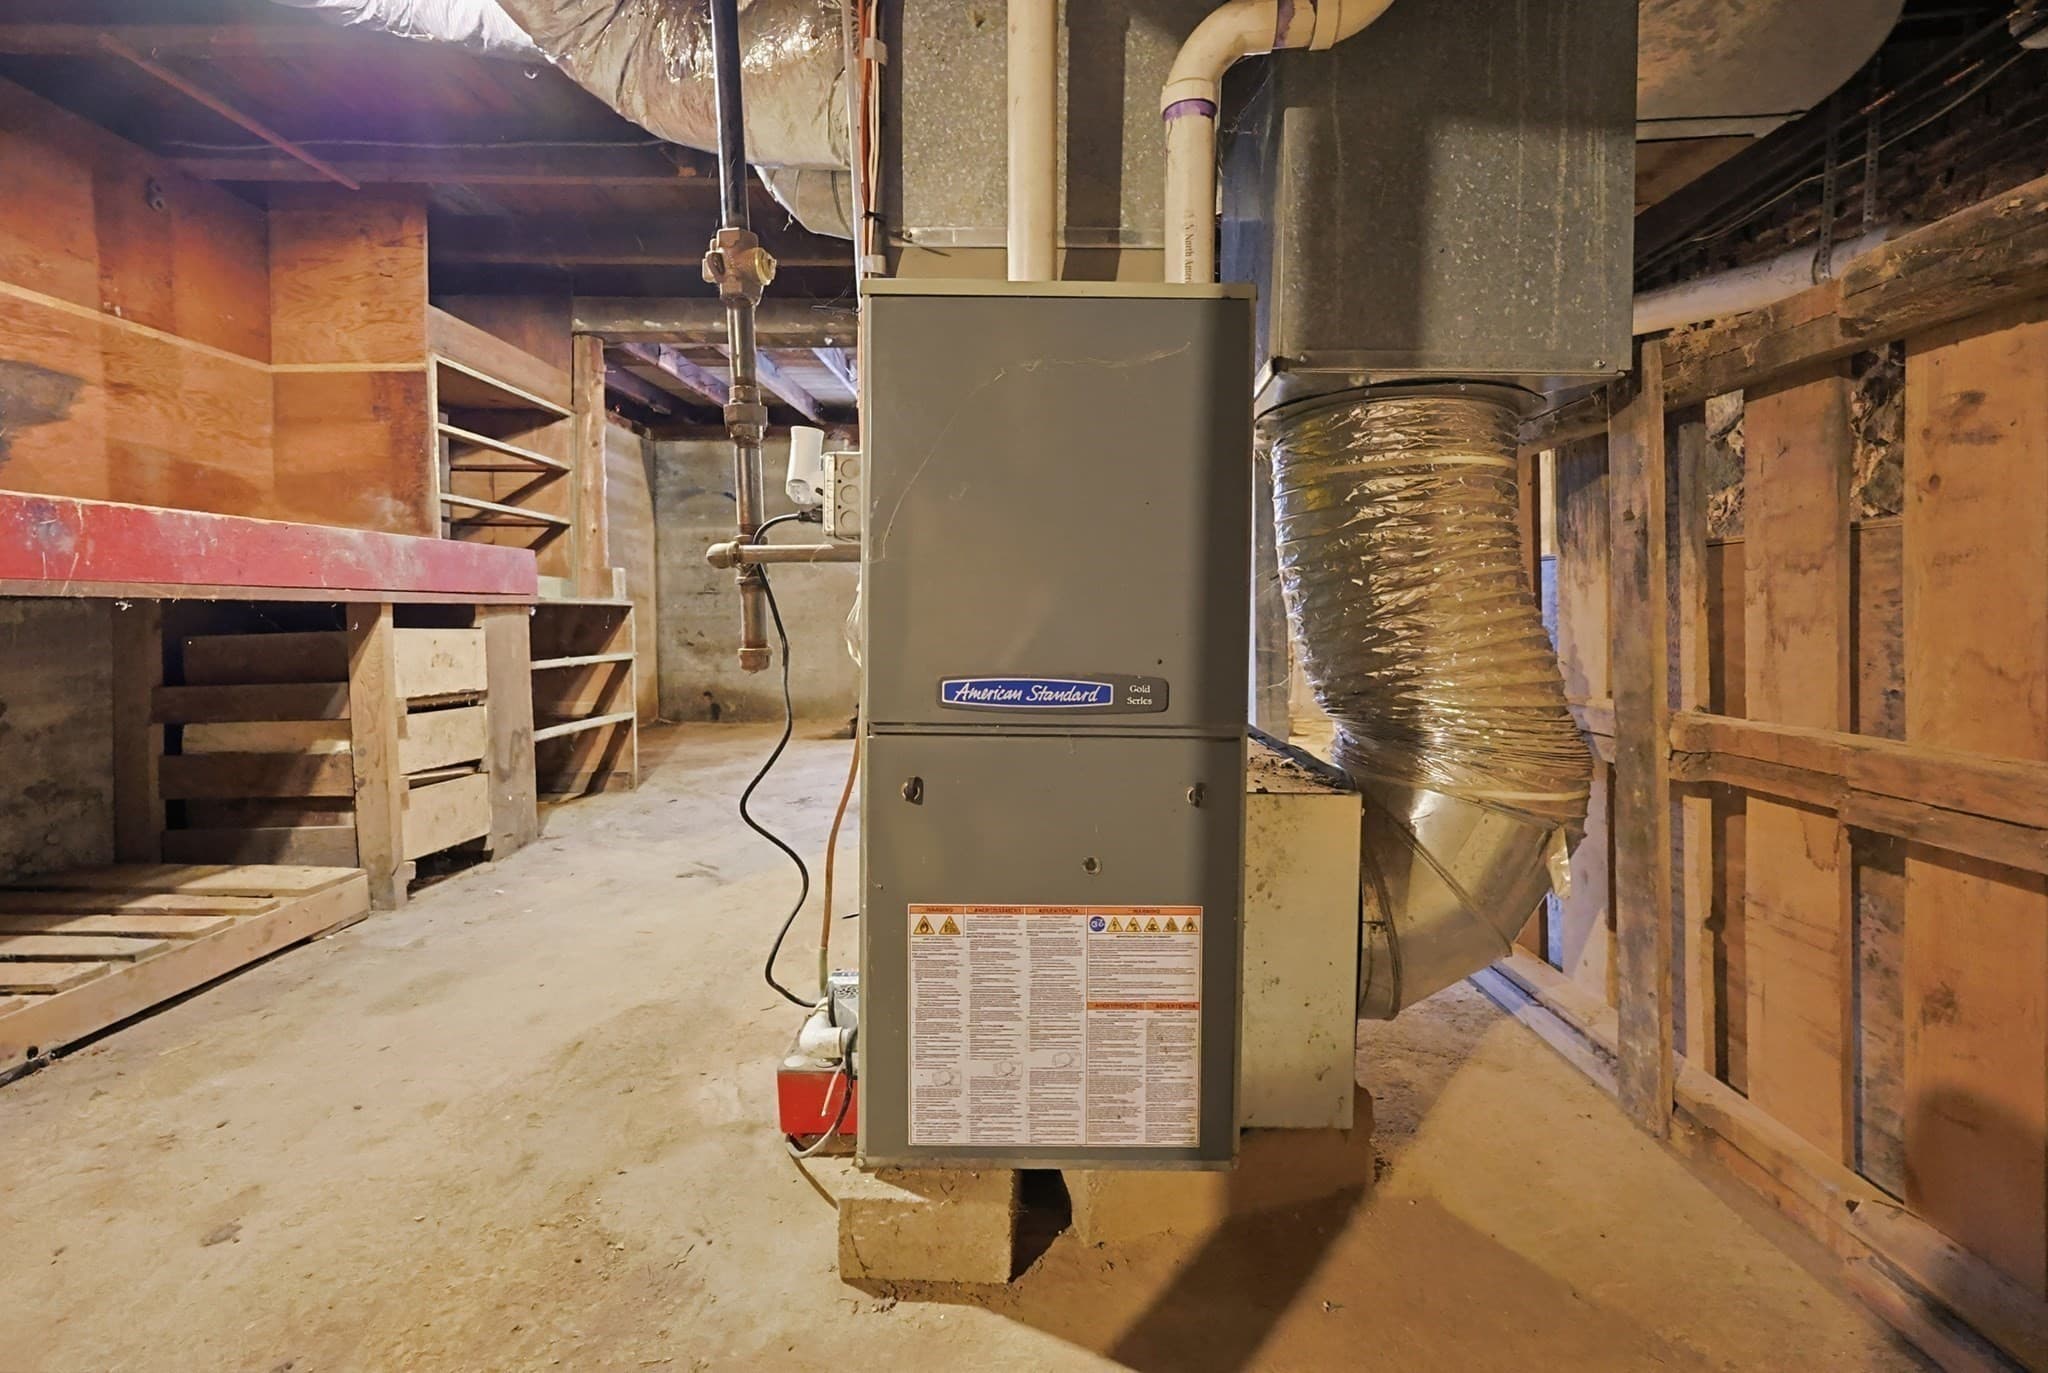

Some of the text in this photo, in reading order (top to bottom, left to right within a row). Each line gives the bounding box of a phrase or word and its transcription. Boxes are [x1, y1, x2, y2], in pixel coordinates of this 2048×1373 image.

[953, 682, 1102, 703] American Standard
[1129, 684, 1151, 694] Gold
[1126, 695, 1153, 705] Series
